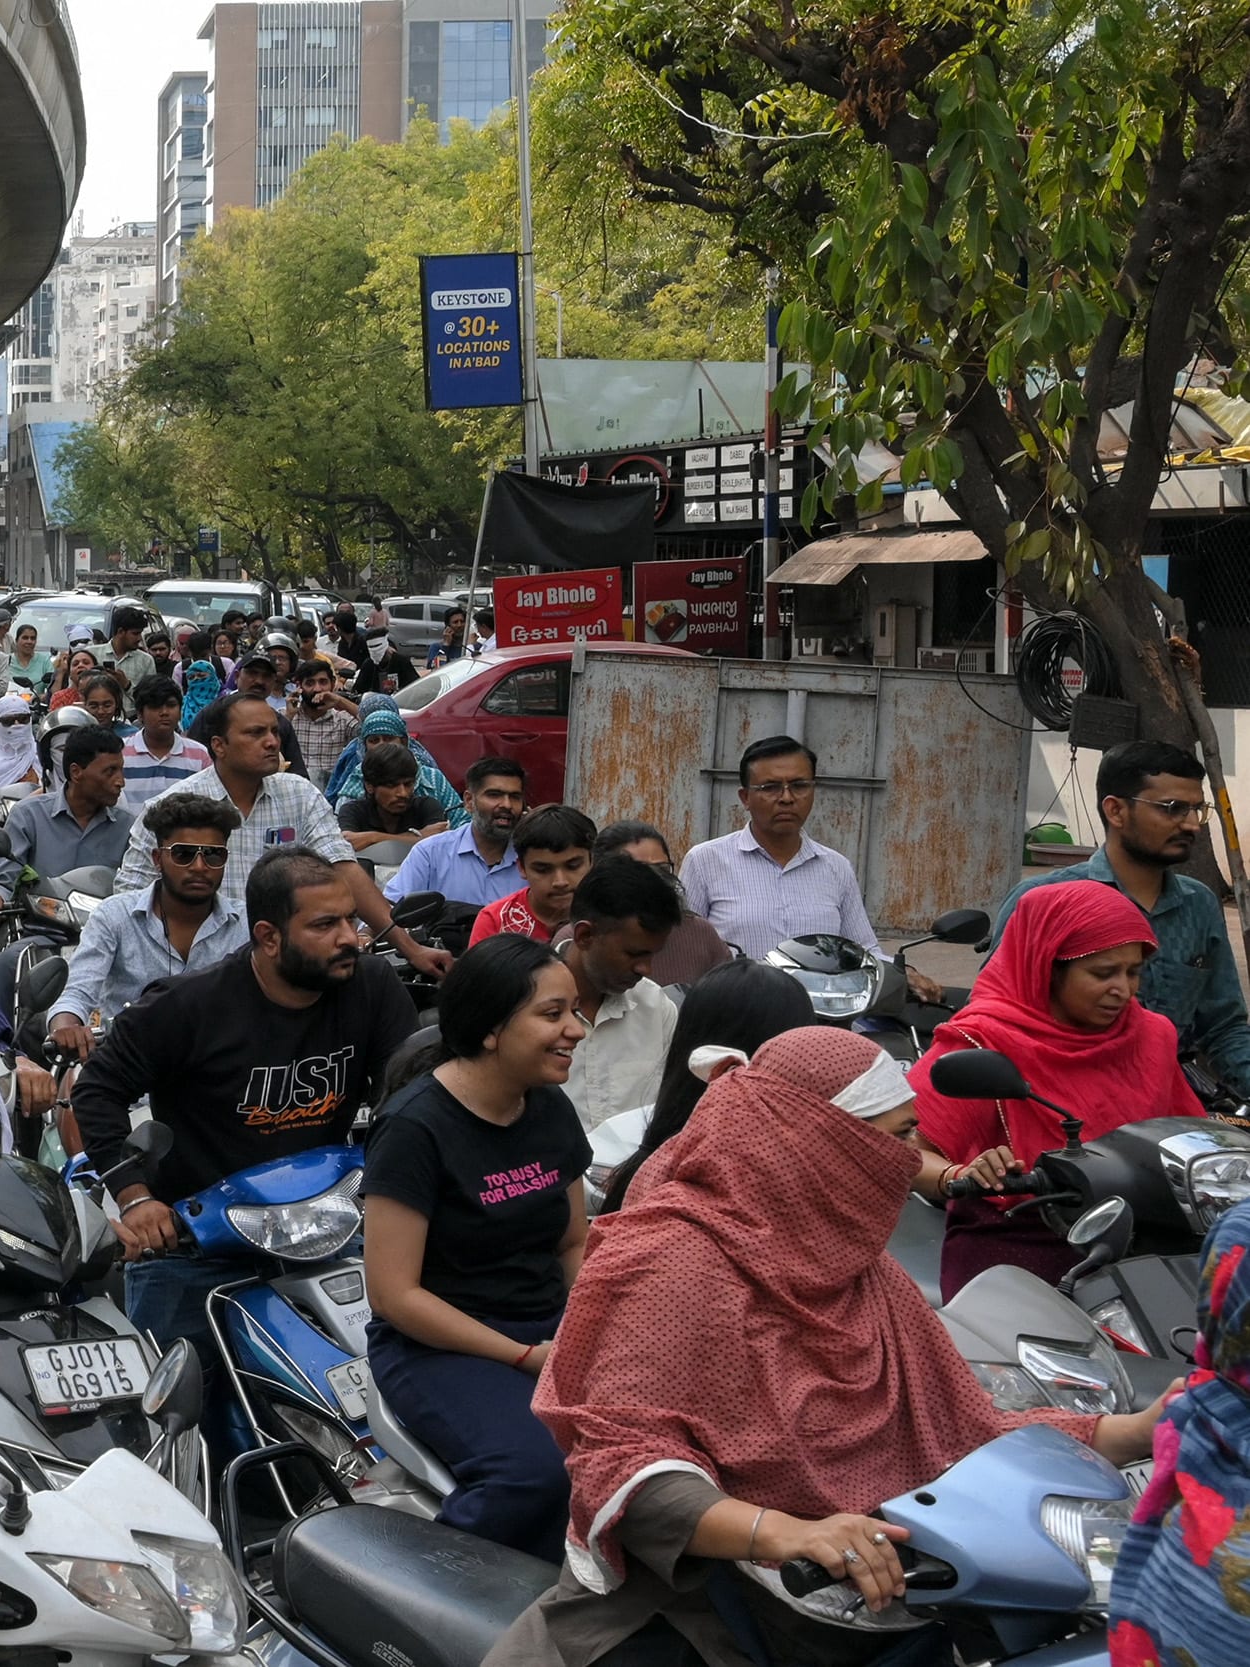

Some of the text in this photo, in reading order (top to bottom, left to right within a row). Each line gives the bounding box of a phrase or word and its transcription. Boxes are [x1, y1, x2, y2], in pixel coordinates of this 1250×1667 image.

[437, 292, 506, 306] KEYSTONE
[444, 315, 500, 337] @ 30+
[436, 340, 511, 355] LOCATIONS
[449, 356, 500, 369] IN A'BAD
[691, 570, 733, 583] Jay Bhole
[516, 585, 596, 608] Jay Bhole
[689, 621, 739, 635] PAVBHAJI
[237, 1045, 354, 1114] JUST
[483, 1162, 542, 1189] TOO BUSY
[479, 1169, 559, 1205] FOR BULLSHIT
[47, 1342, 124, 1372] GJ01X
